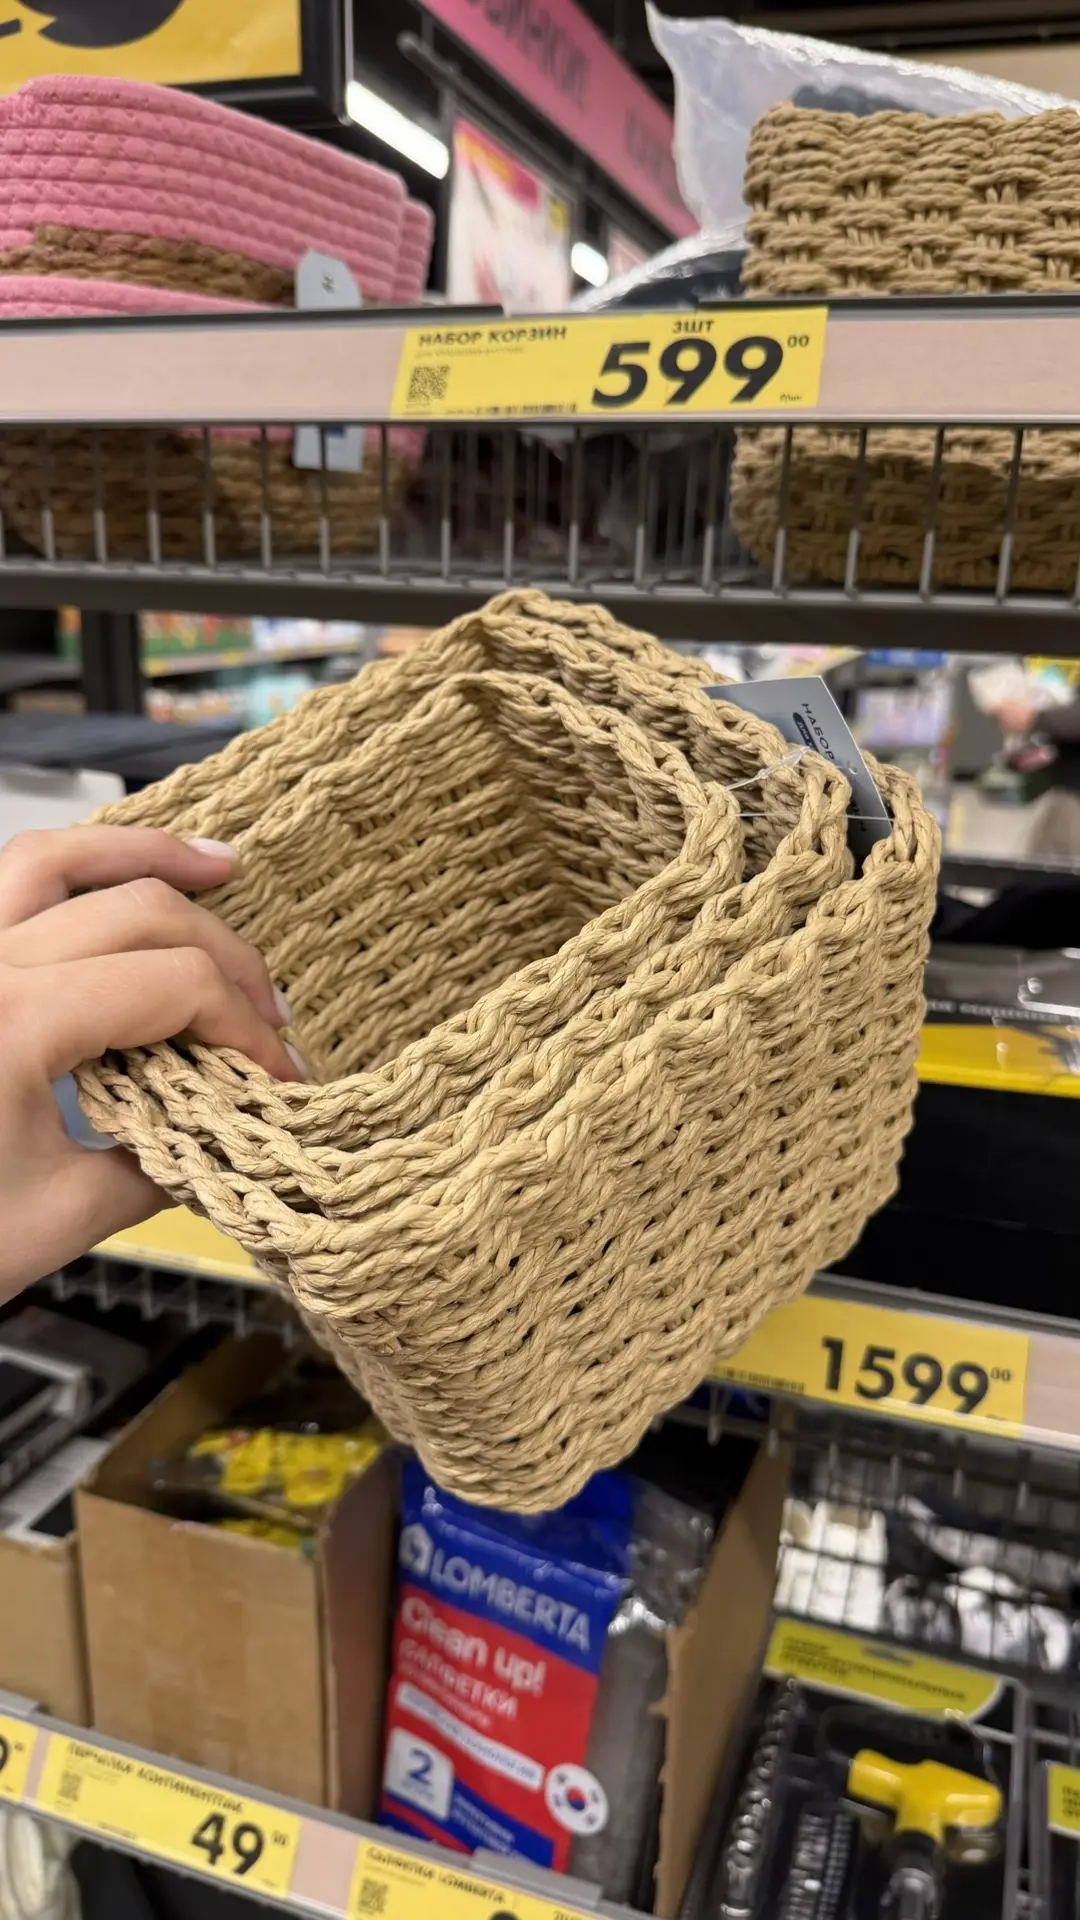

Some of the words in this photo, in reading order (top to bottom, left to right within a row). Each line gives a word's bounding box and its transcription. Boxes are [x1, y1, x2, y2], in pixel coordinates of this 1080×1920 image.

[418, 332, 482, 347] НАБОР
[488, 326, 567, 343] КОРЗИН
[672, 320, 714, 333] 3ШТ
[591, 336, 784, 409] 599
[787, 335, 810, 348] 00
[801, 703, 835, 760] НАБОР
[822, 1335, 990, 1415] 1599
[990, 1366, 1012, 1382] 00
[429, 1548, 590, 1654] LOMBERTA
[492, 1646, 547, 1697] up!
[406, 1749, 434, 1786] 2
[191, 1812, 265, 1876] 49
